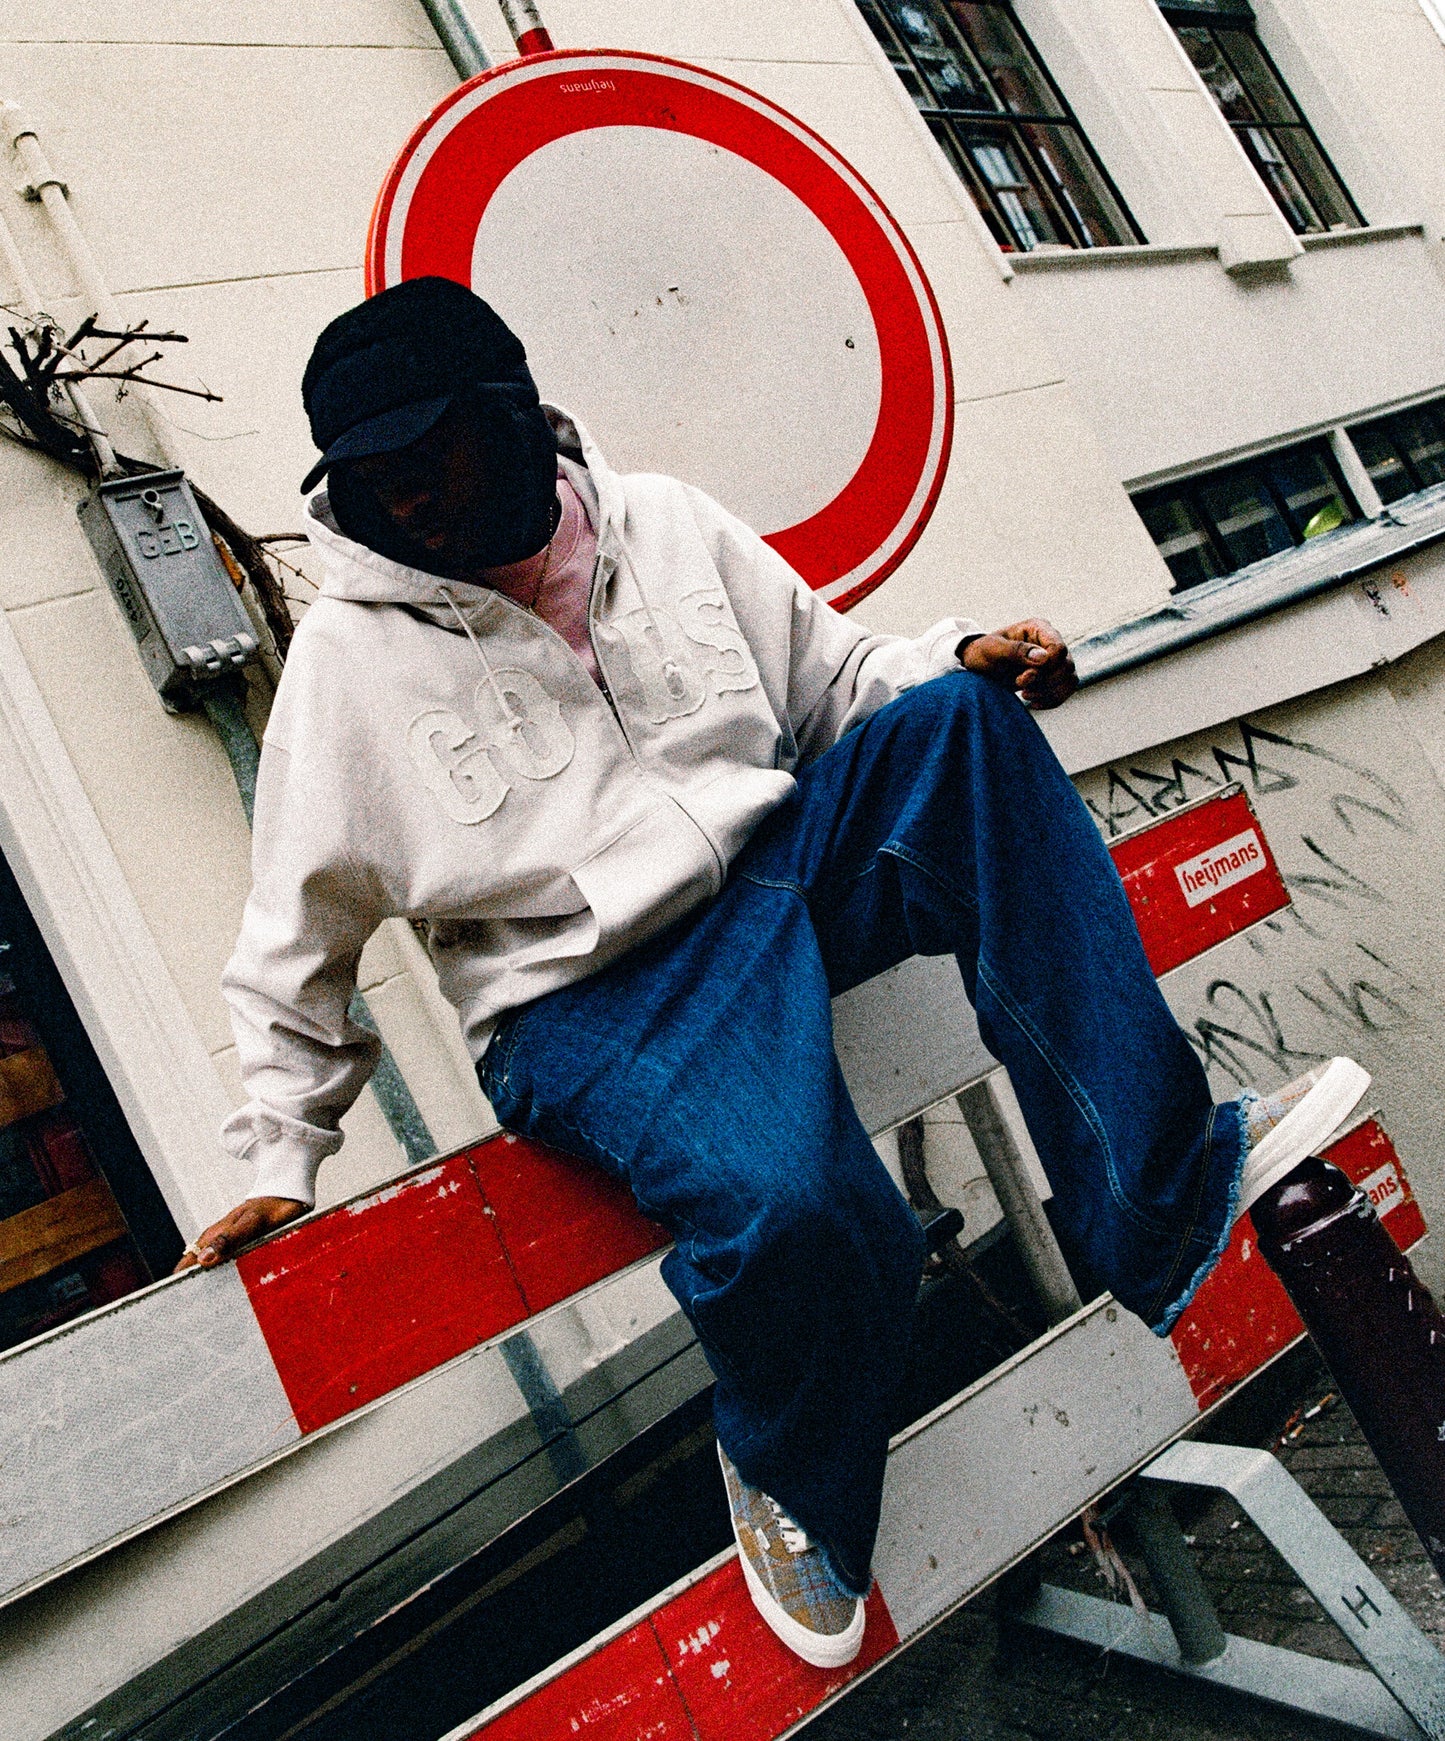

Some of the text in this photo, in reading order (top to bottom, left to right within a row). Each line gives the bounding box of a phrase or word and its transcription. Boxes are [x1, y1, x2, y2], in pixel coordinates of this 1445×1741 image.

[136, 520, 199, 560] GEB
[1182, 842, 1259, 893] heijmans
[1341, 1585, 1382, 1629] H
